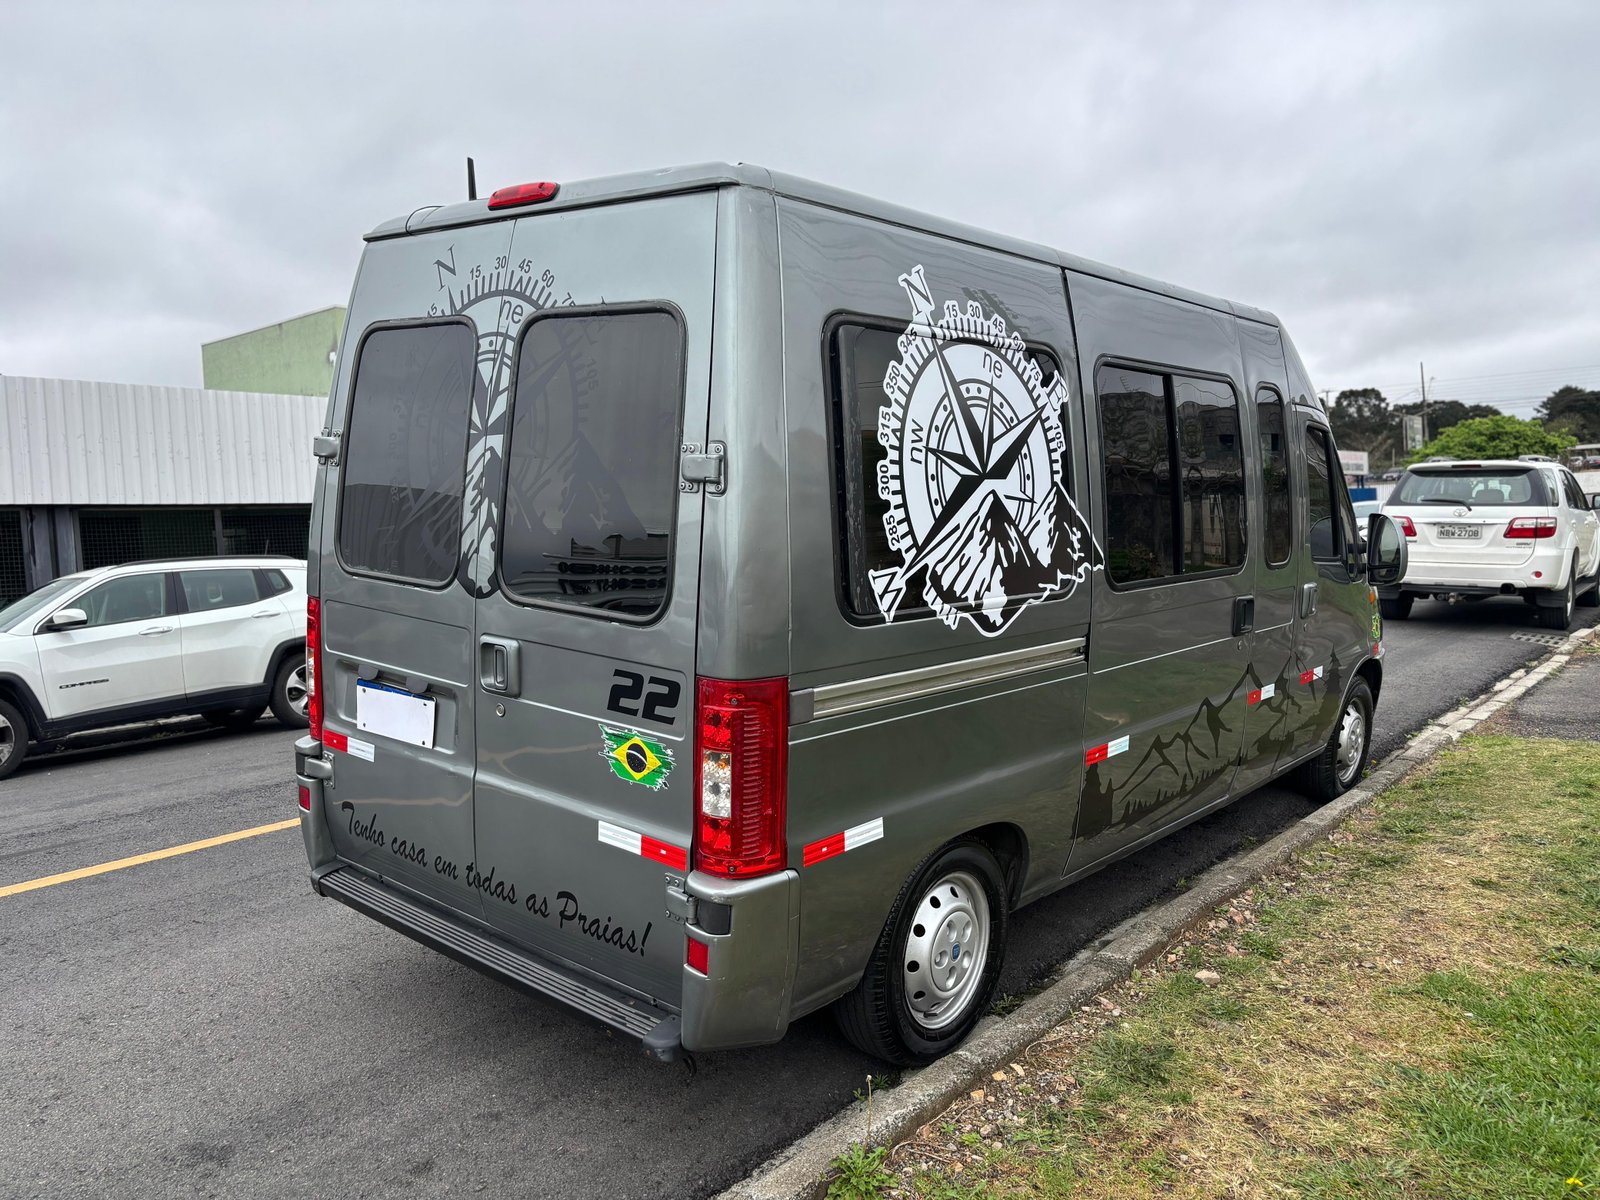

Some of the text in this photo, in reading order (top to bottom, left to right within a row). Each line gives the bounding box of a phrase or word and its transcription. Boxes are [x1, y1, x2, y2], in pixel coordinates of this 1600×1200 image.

[433, 244, 456, 291] N
[470, 265, 481, 280] 15
[495, 255, 507, 270] 30
[518, 258, 532, 274] 45
[541, 269, 555, 288] 60
[901, 269, 932, 315] N
[500, 299, 523, 324] ne
[946, 304, 958, 318] 15
[969, 304, 981, 319] 30
[992, 318, 1004, 333] 45
[899, 327, 918, 354] 345
[983, 351, 1003, 379] ne
[1029, 362, 1041, 381] 75
[885, 365, 900, 394] 350
[880, 410, 891, 442] 315
[1053, 423, 1064, 449] 105
[879, 464, 890, 495] 300
[885, 514, 901, 547] 285
[607, 668, 681, 725] 22
[342, 801, 653, 957] Tenho casa em todas as Praias!
